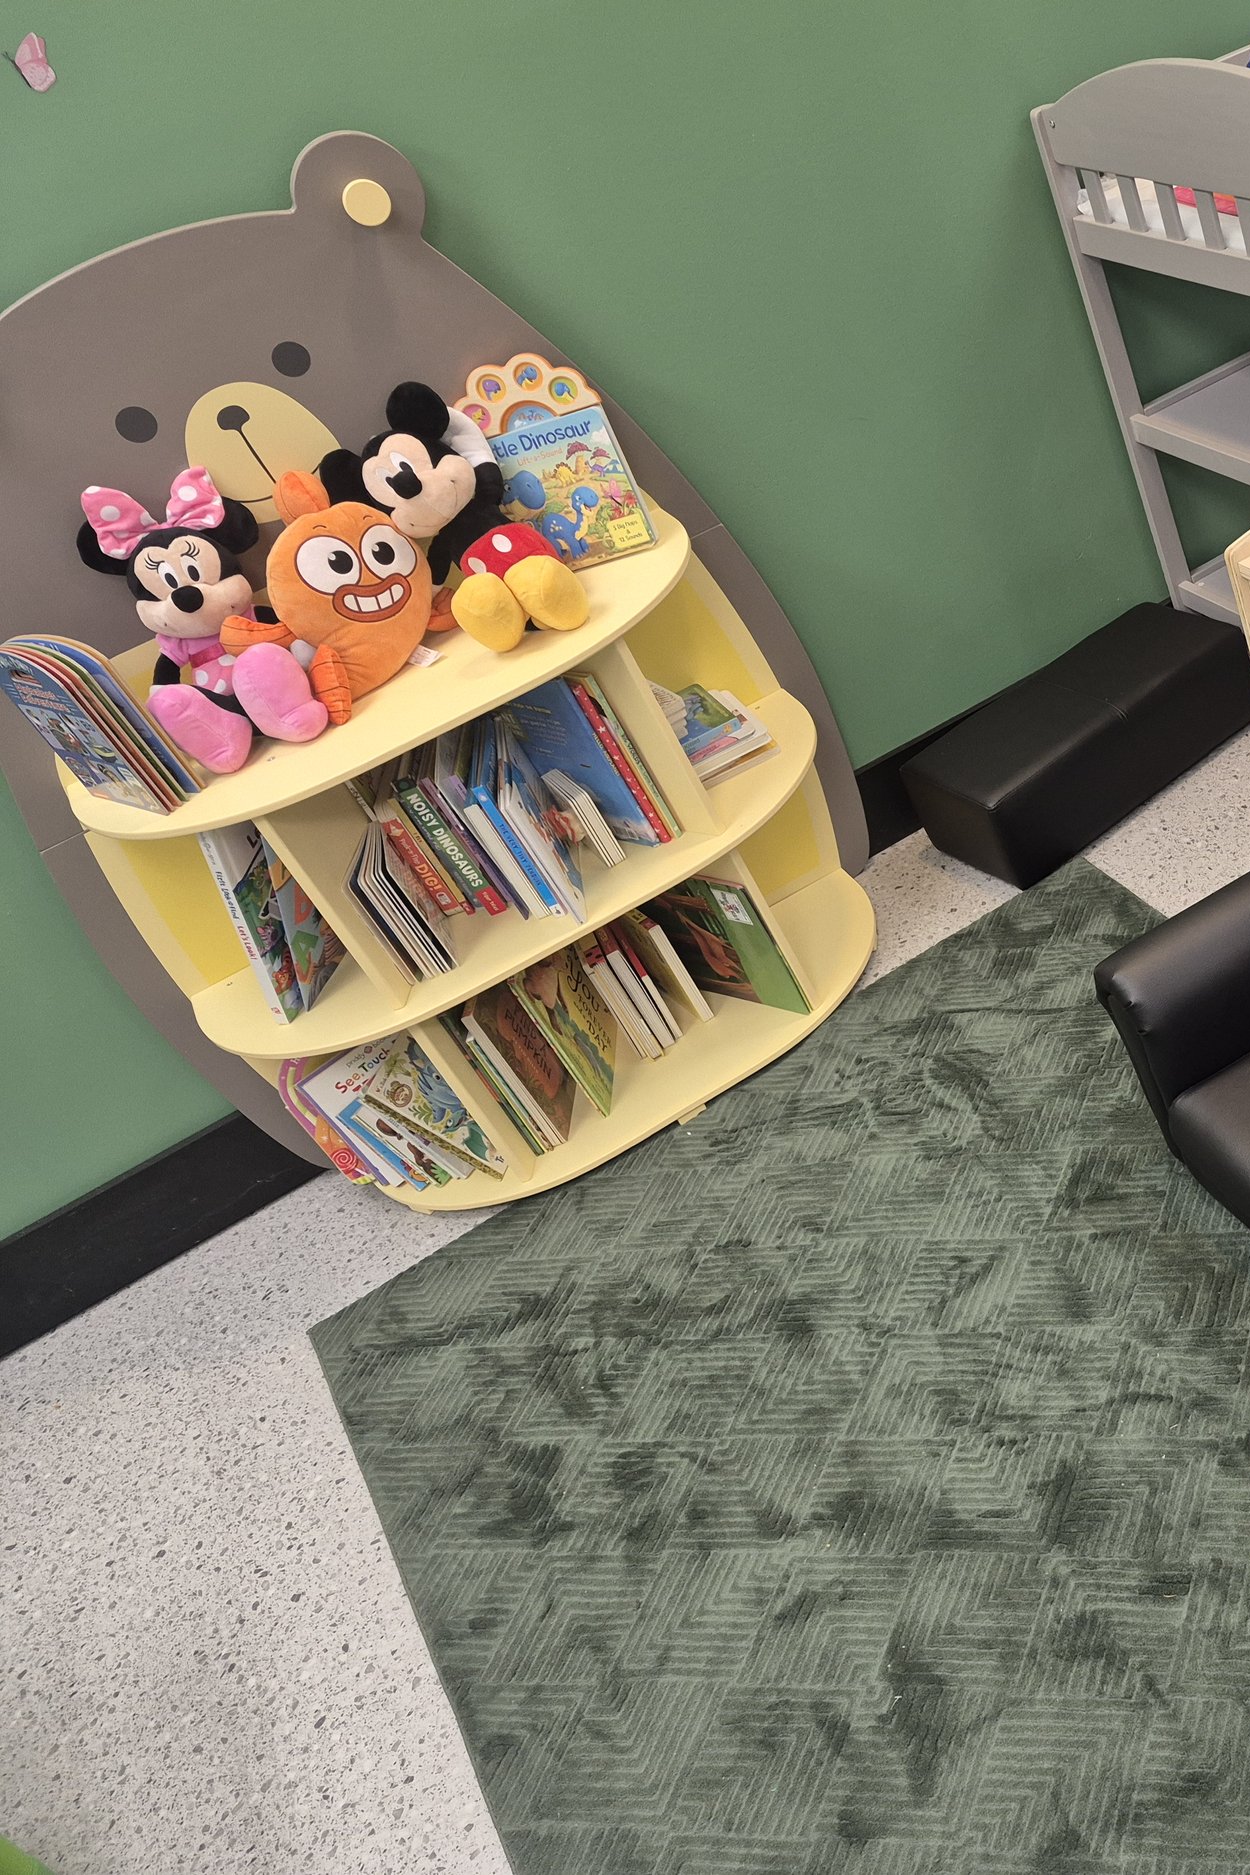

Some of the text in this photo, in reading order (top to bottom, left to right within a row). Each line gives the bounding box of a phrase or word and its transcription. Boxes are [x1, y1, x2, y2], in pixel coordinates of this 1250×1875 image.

[492, 420, 591, 461] tle Dinosaur
[406, 792, 439, 833] NOISY
[431, 827, 484, 888] DINOSAURS
[414, 863, 443, 891] DIG!
[245, 941, 258, 960] Look!
[505, 1008, 553, 1078] PUMPKIN
[586, 1020, 608, 1052] DAY
[334, 1070, 366, 1095] See,
